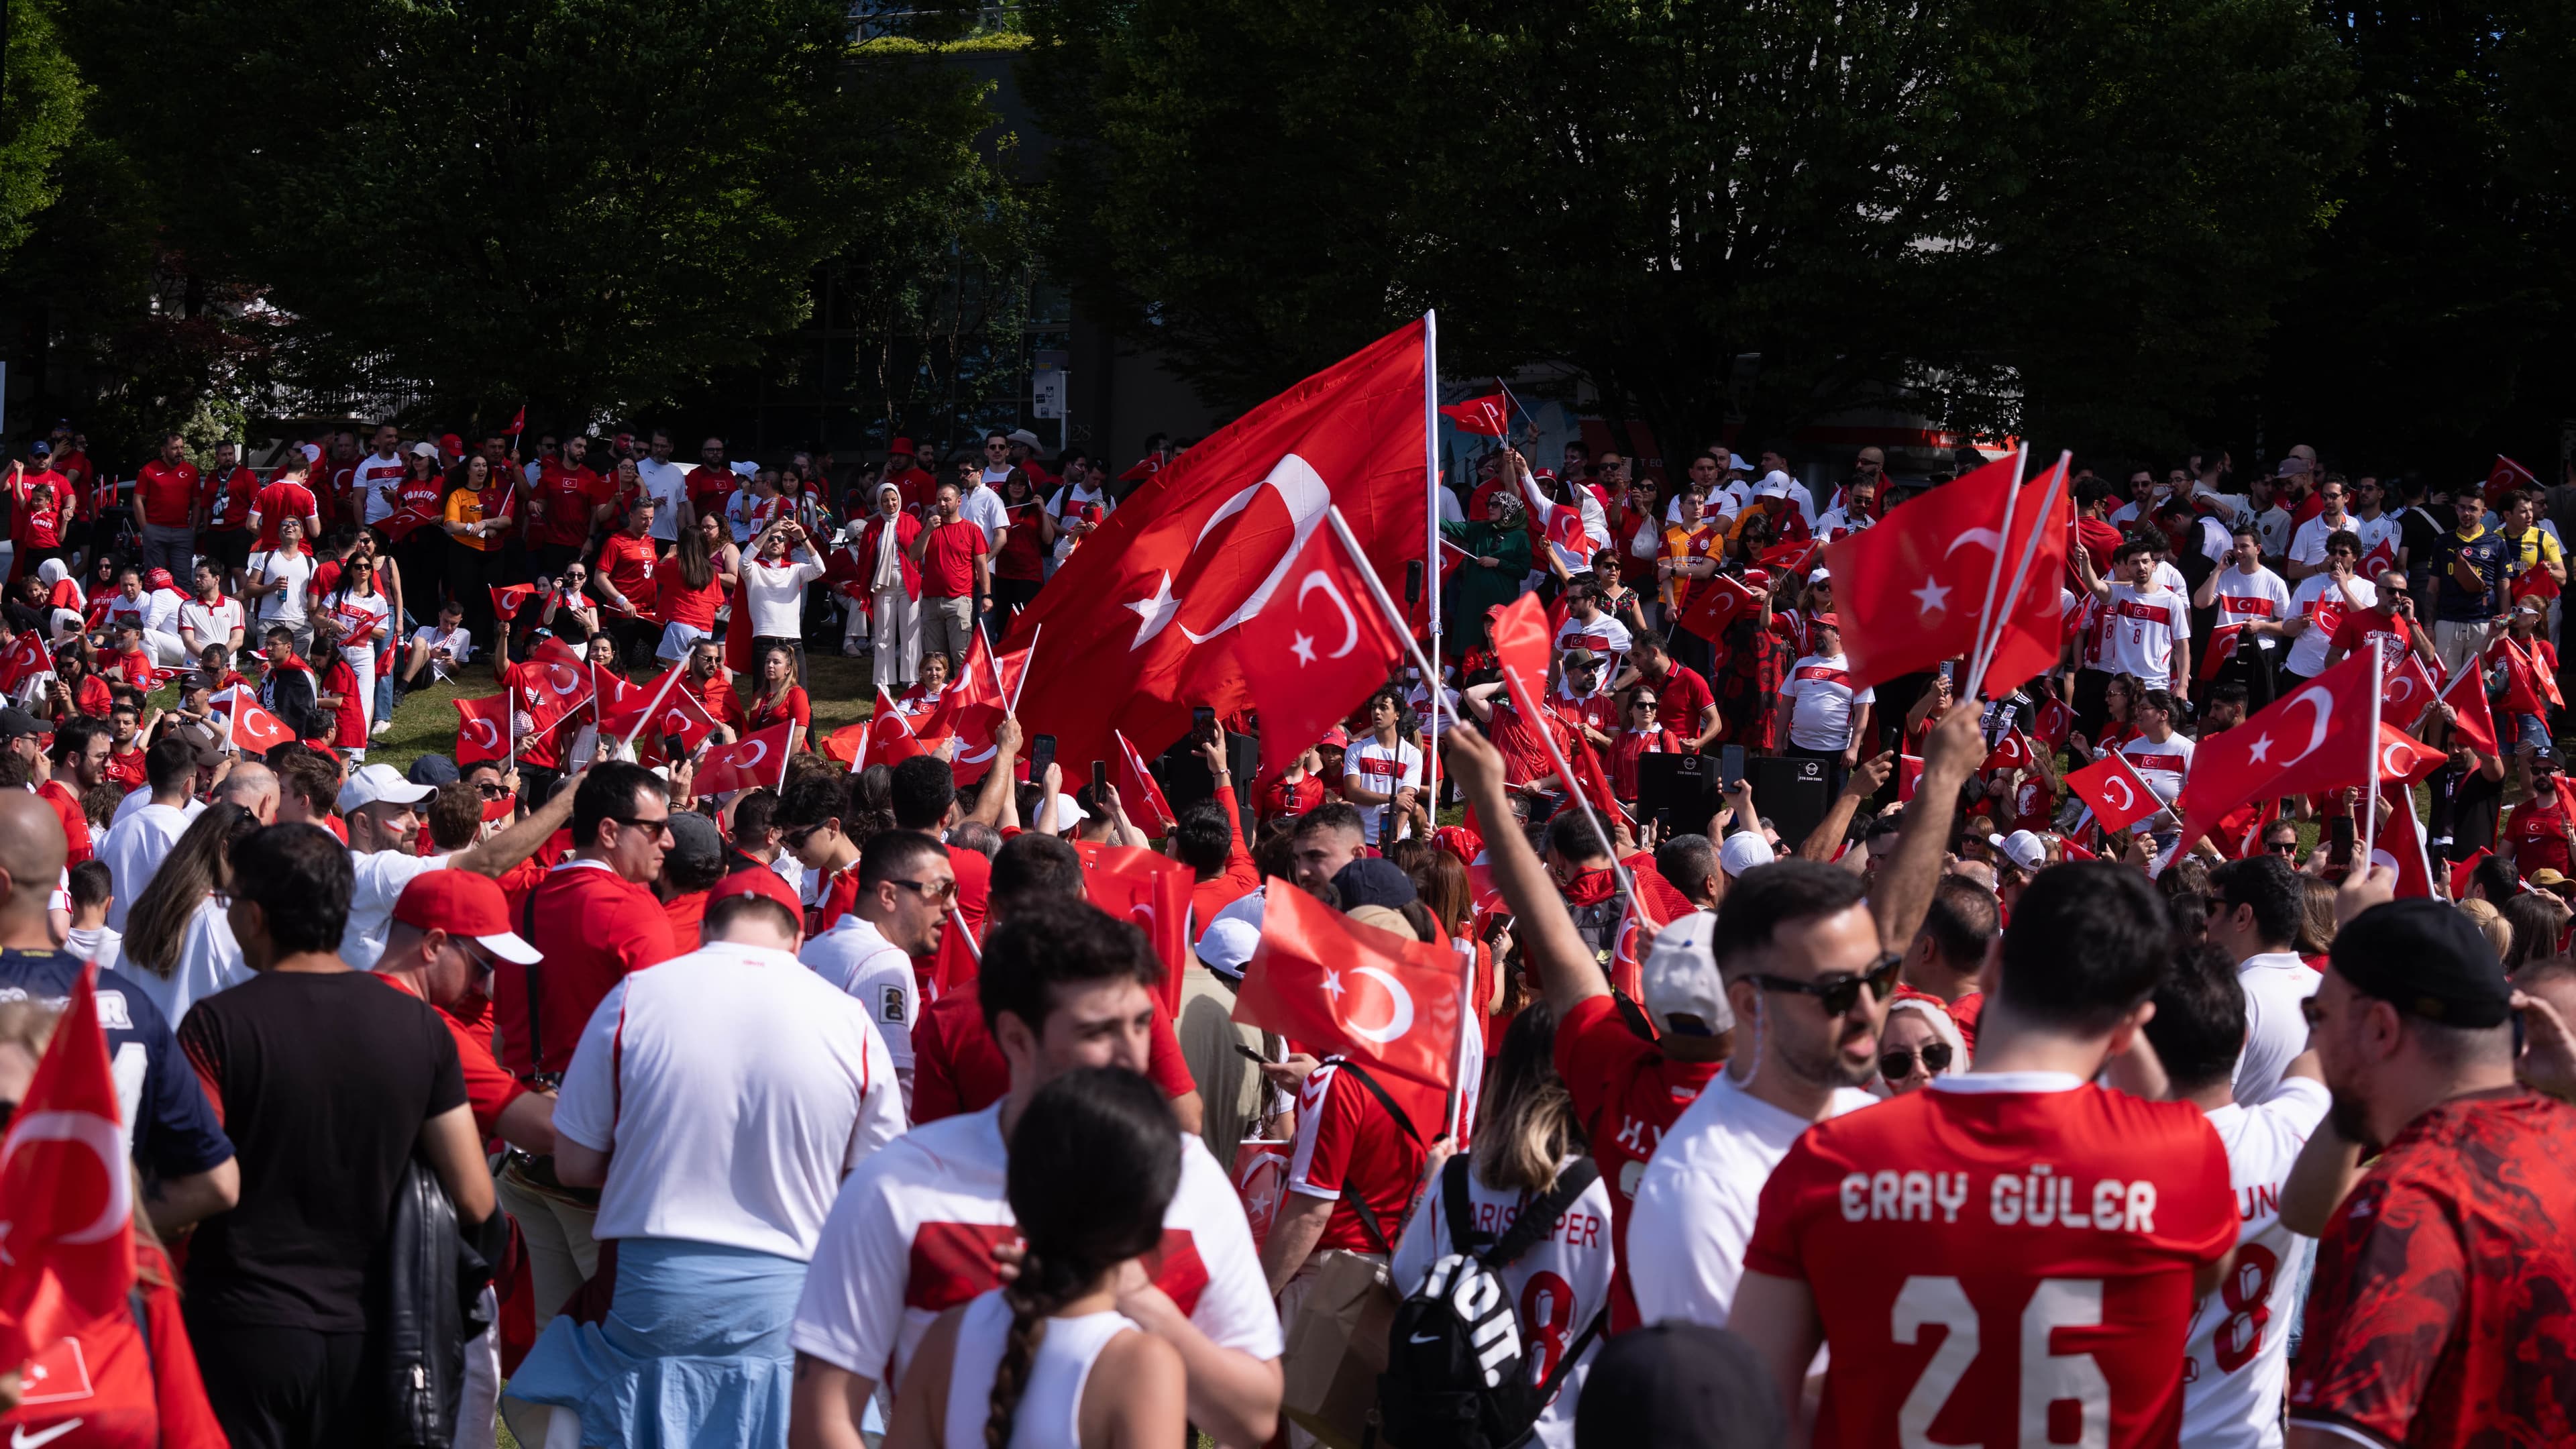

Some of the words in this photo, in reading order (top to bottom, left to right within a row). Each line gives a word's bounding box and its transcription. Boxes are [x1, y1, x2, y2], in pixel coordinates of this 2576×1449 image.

[2106, 625, 2113, 639] 8
[2133, 629, 2141, 644] 8
[1983, 716, 2006, 728] beko
[1840, 1170, 1968, 1223] ERAY
[1990, 1165, 2157, 1232] GÜLER
[1890, 1275, 2110, 1449] 26
